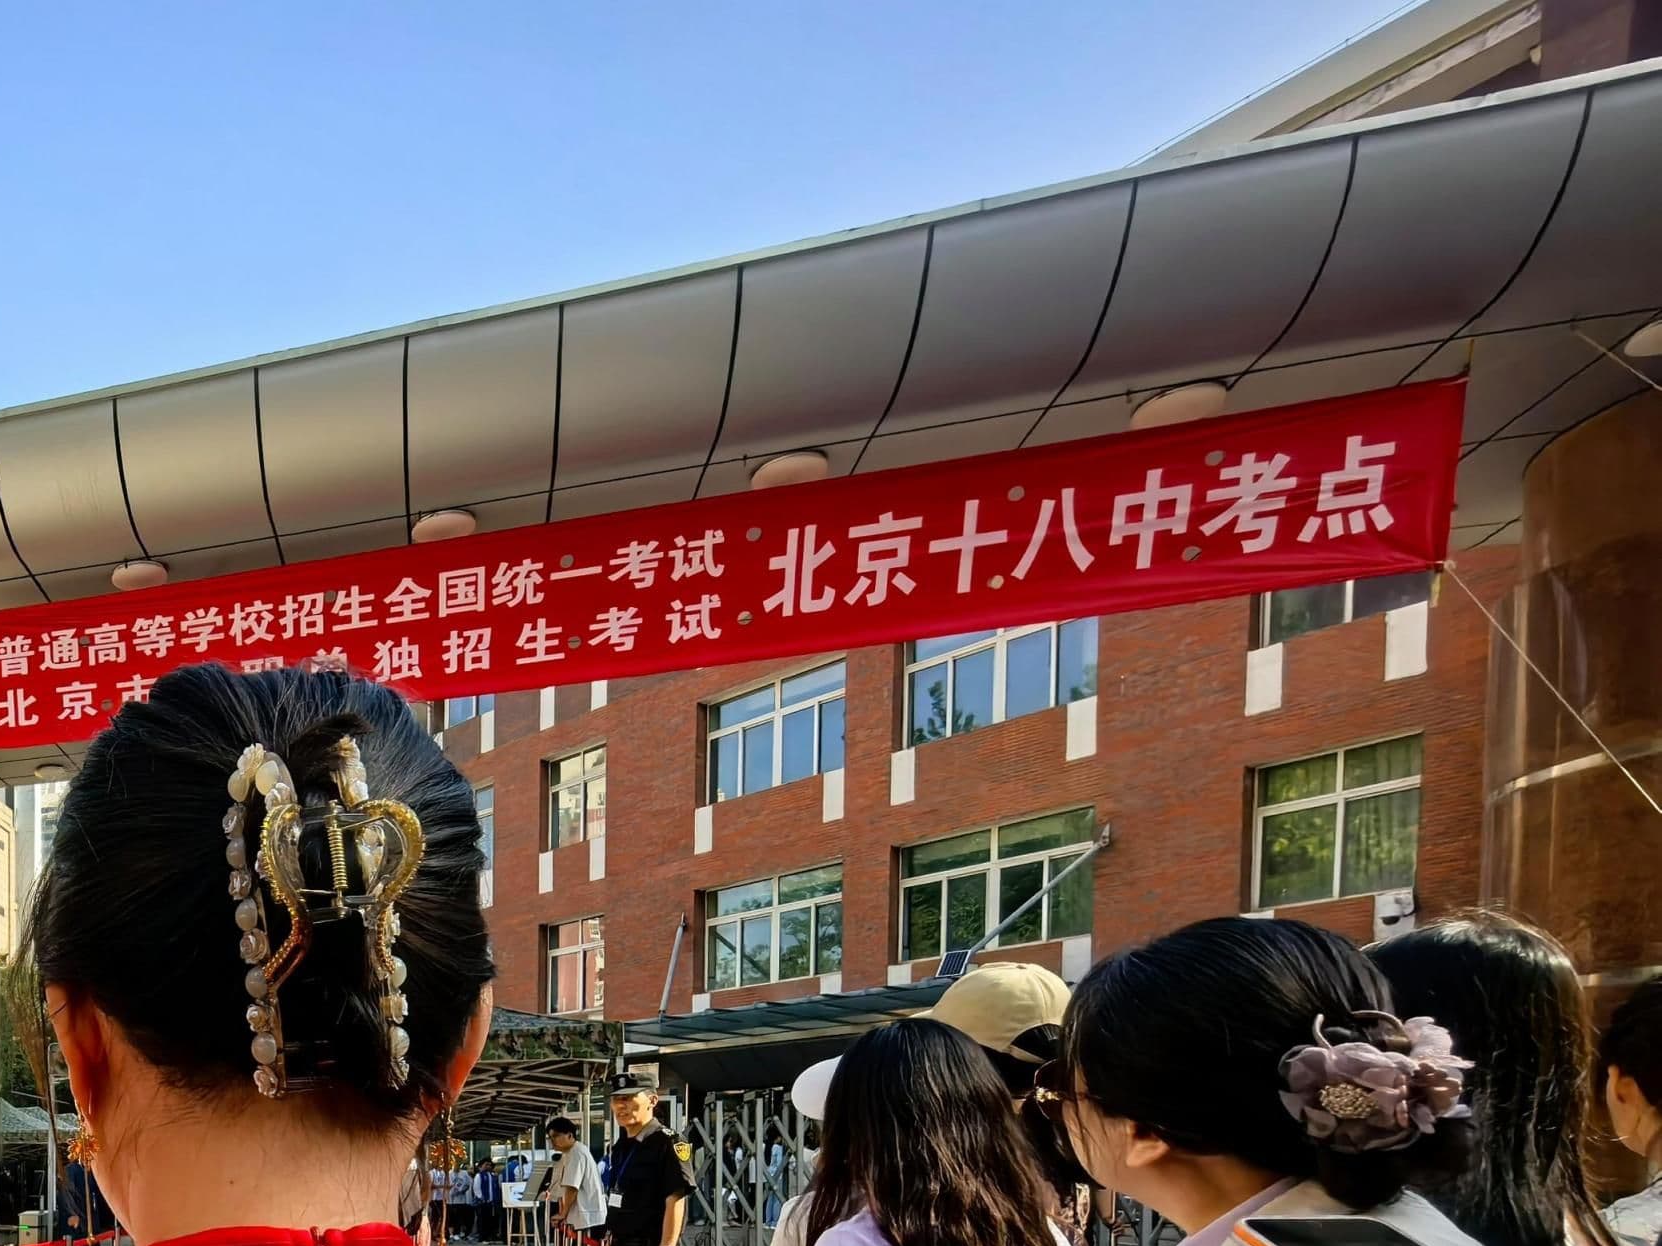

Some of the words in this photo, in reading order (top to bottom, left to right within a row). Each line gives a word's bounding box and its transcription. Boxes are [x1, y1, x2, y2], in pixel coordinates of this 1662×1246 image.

[762, 435, 1398, 617] 北京十八中考点
